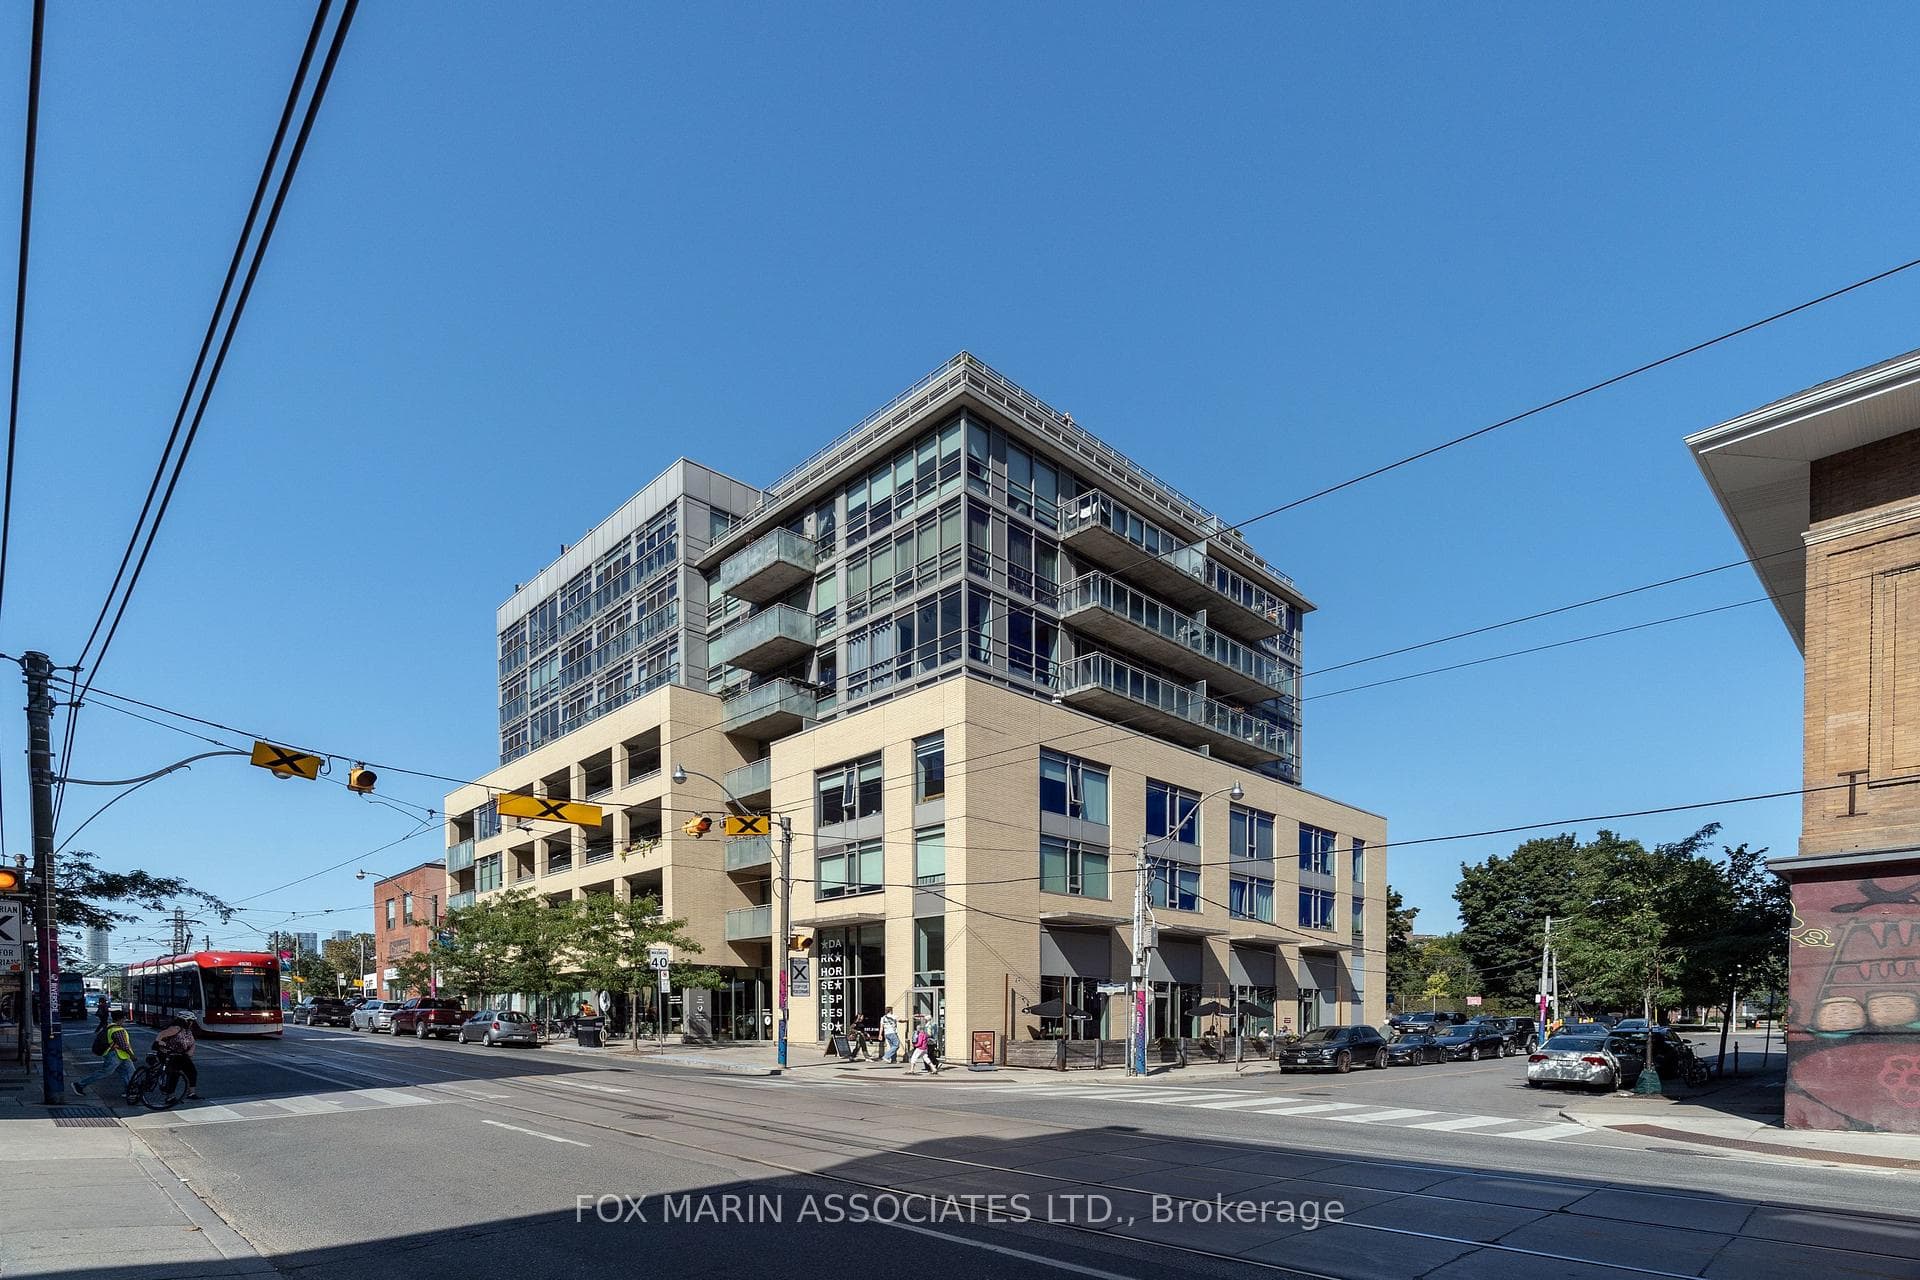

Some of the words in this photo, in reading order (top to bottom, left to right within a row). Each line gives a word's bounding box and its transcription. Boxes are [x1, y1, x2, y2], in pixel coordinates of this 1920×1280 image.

[651, 957, 668, 968] 40
[820, 953, 834, 963] RK
[820, 966, 843, 977] HOR
[821, 980, 834, 990] SE
[821, 994, 843, 1004] ESP
[821, 1008, 843, 1017] RES
[821, 1022, 835, 1031] SO
